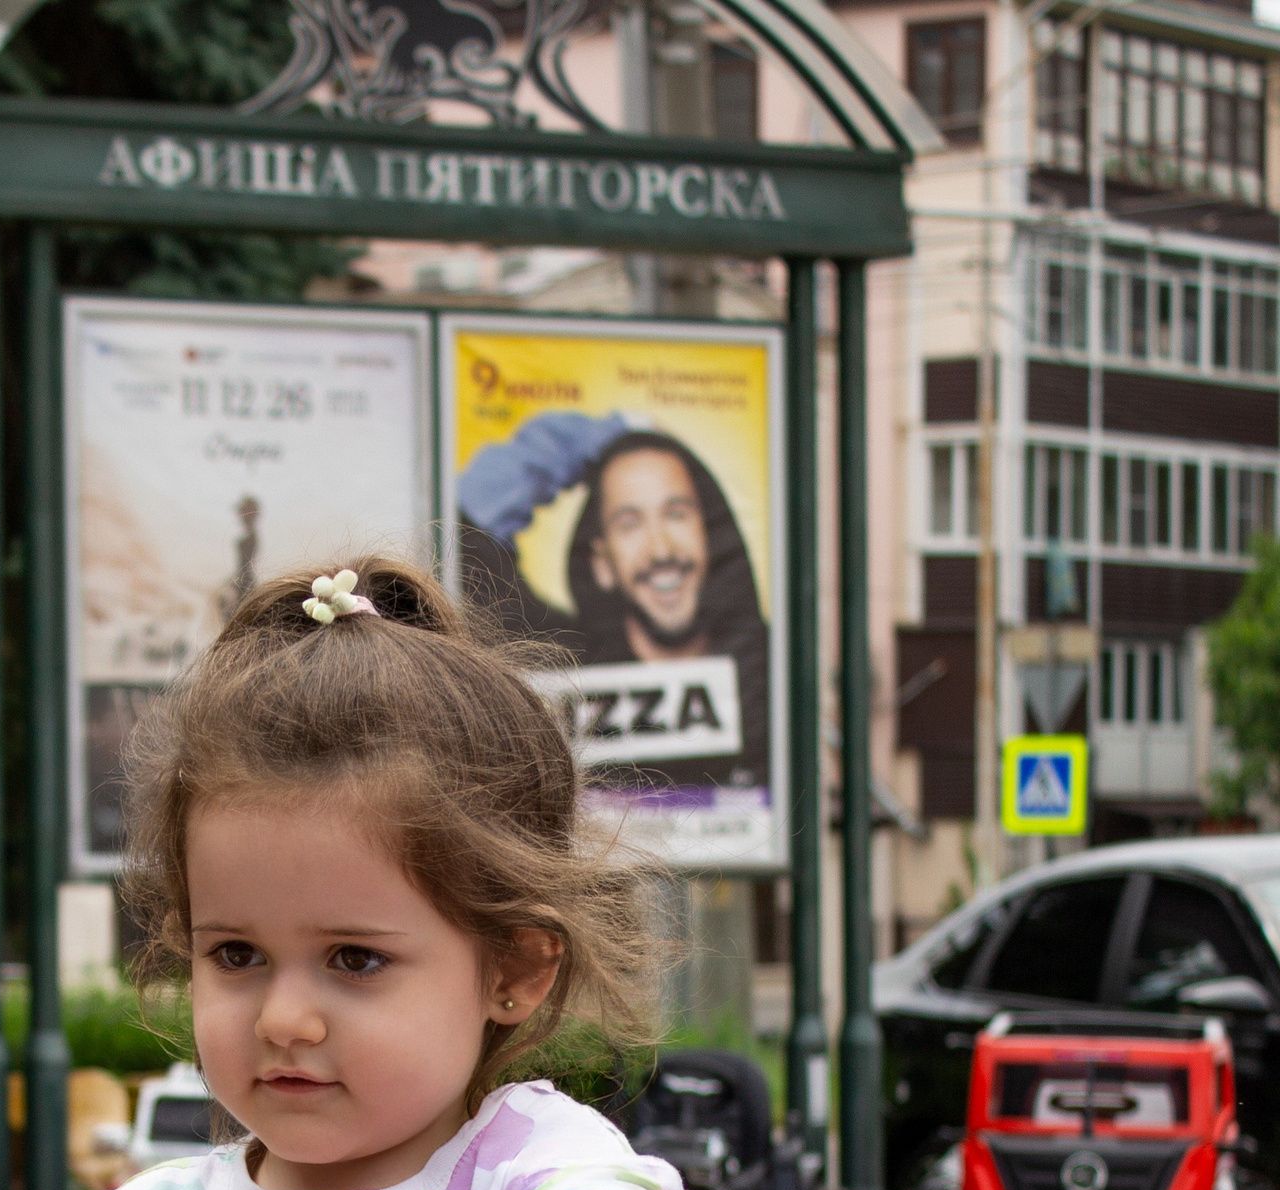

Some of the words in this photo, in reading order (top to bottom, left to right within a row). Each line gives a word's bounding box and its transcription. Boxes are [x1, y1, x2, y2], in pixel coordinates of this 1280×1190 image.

[98, 134, 359, 199] АФИША
[374, 147, 788, 223] ПЯТИГОРСКА
[470, 358, 500, 398] 9
